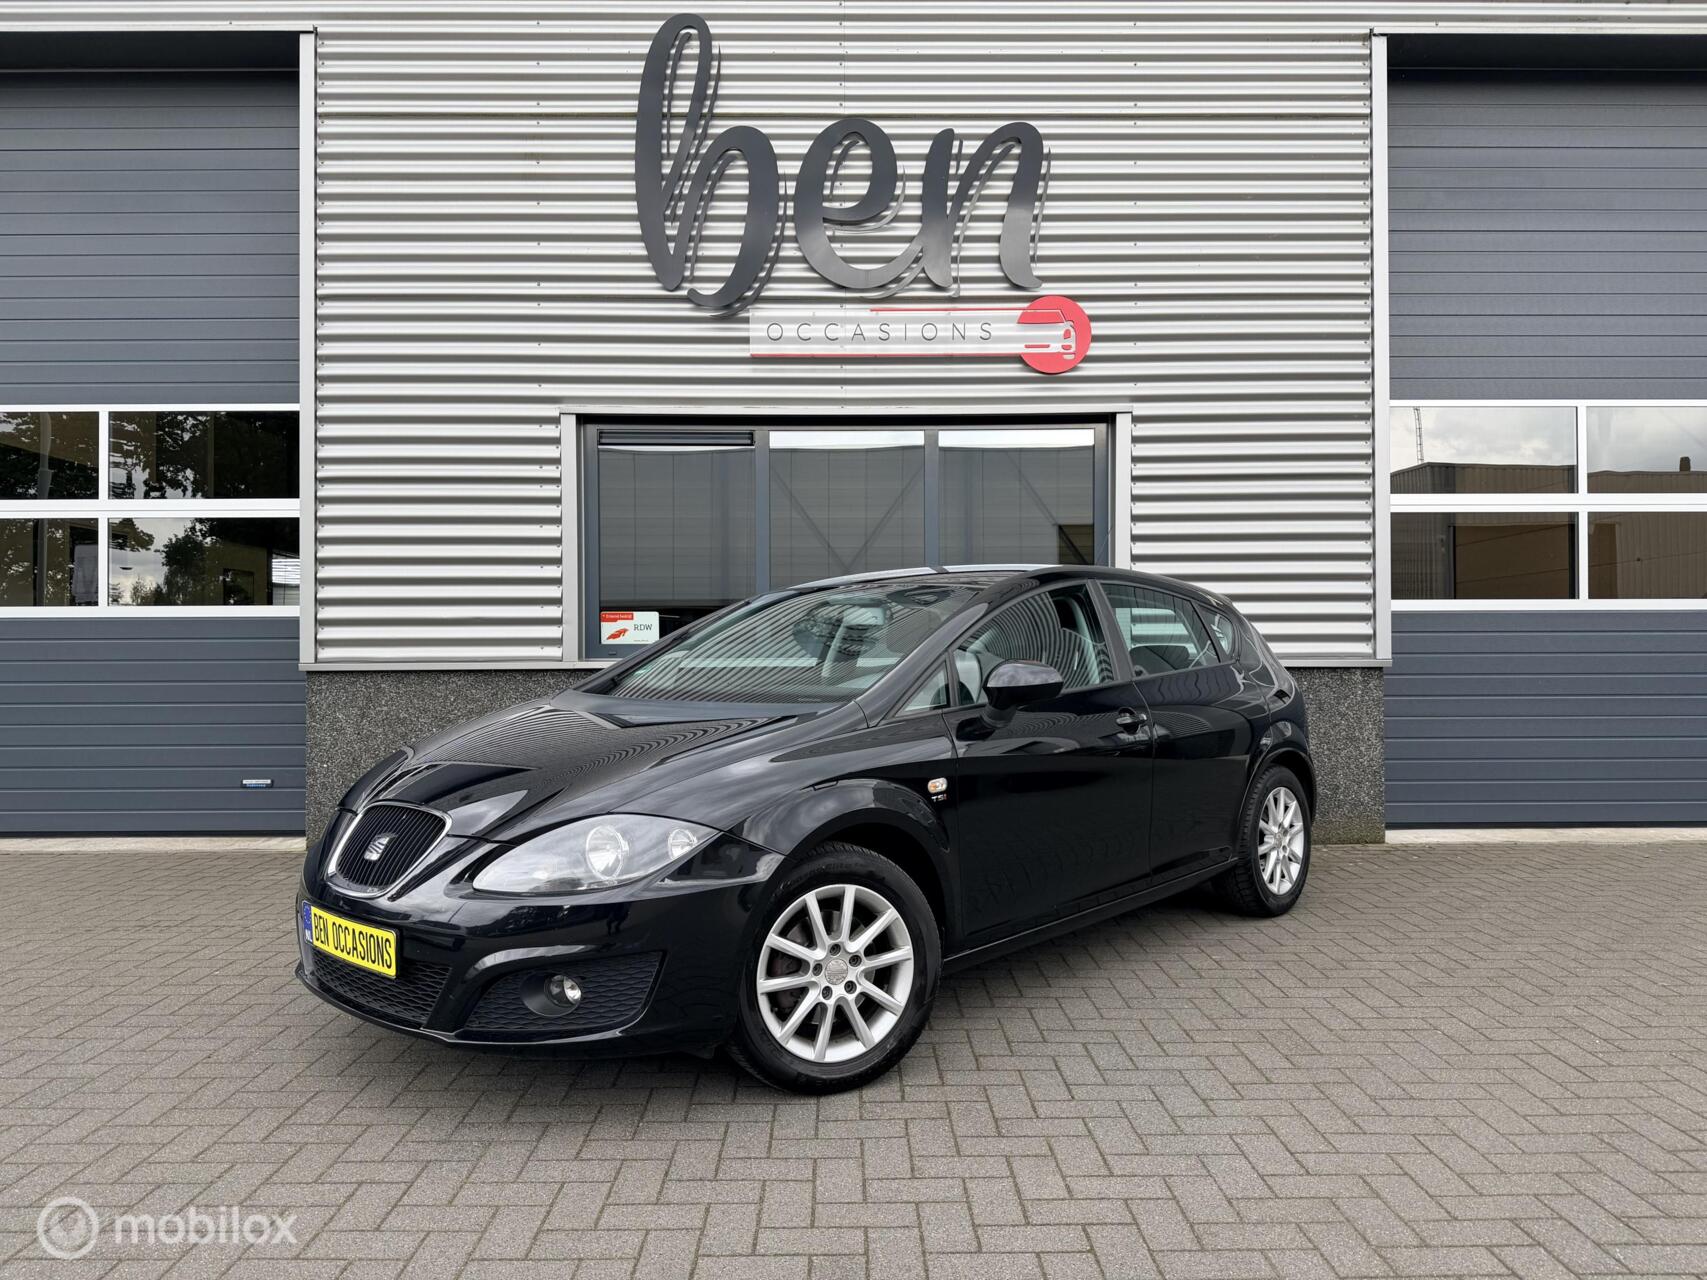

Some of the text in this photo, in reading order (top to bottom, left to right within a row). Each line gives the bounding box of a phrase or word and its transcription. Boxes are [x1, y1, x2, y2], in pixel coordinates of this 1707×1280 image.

[635, 13, 1050, 310] ben
[766, 322, 992, 342] OCCASIONS
[313, 913, 392, 969] BEN OCCASIONS
